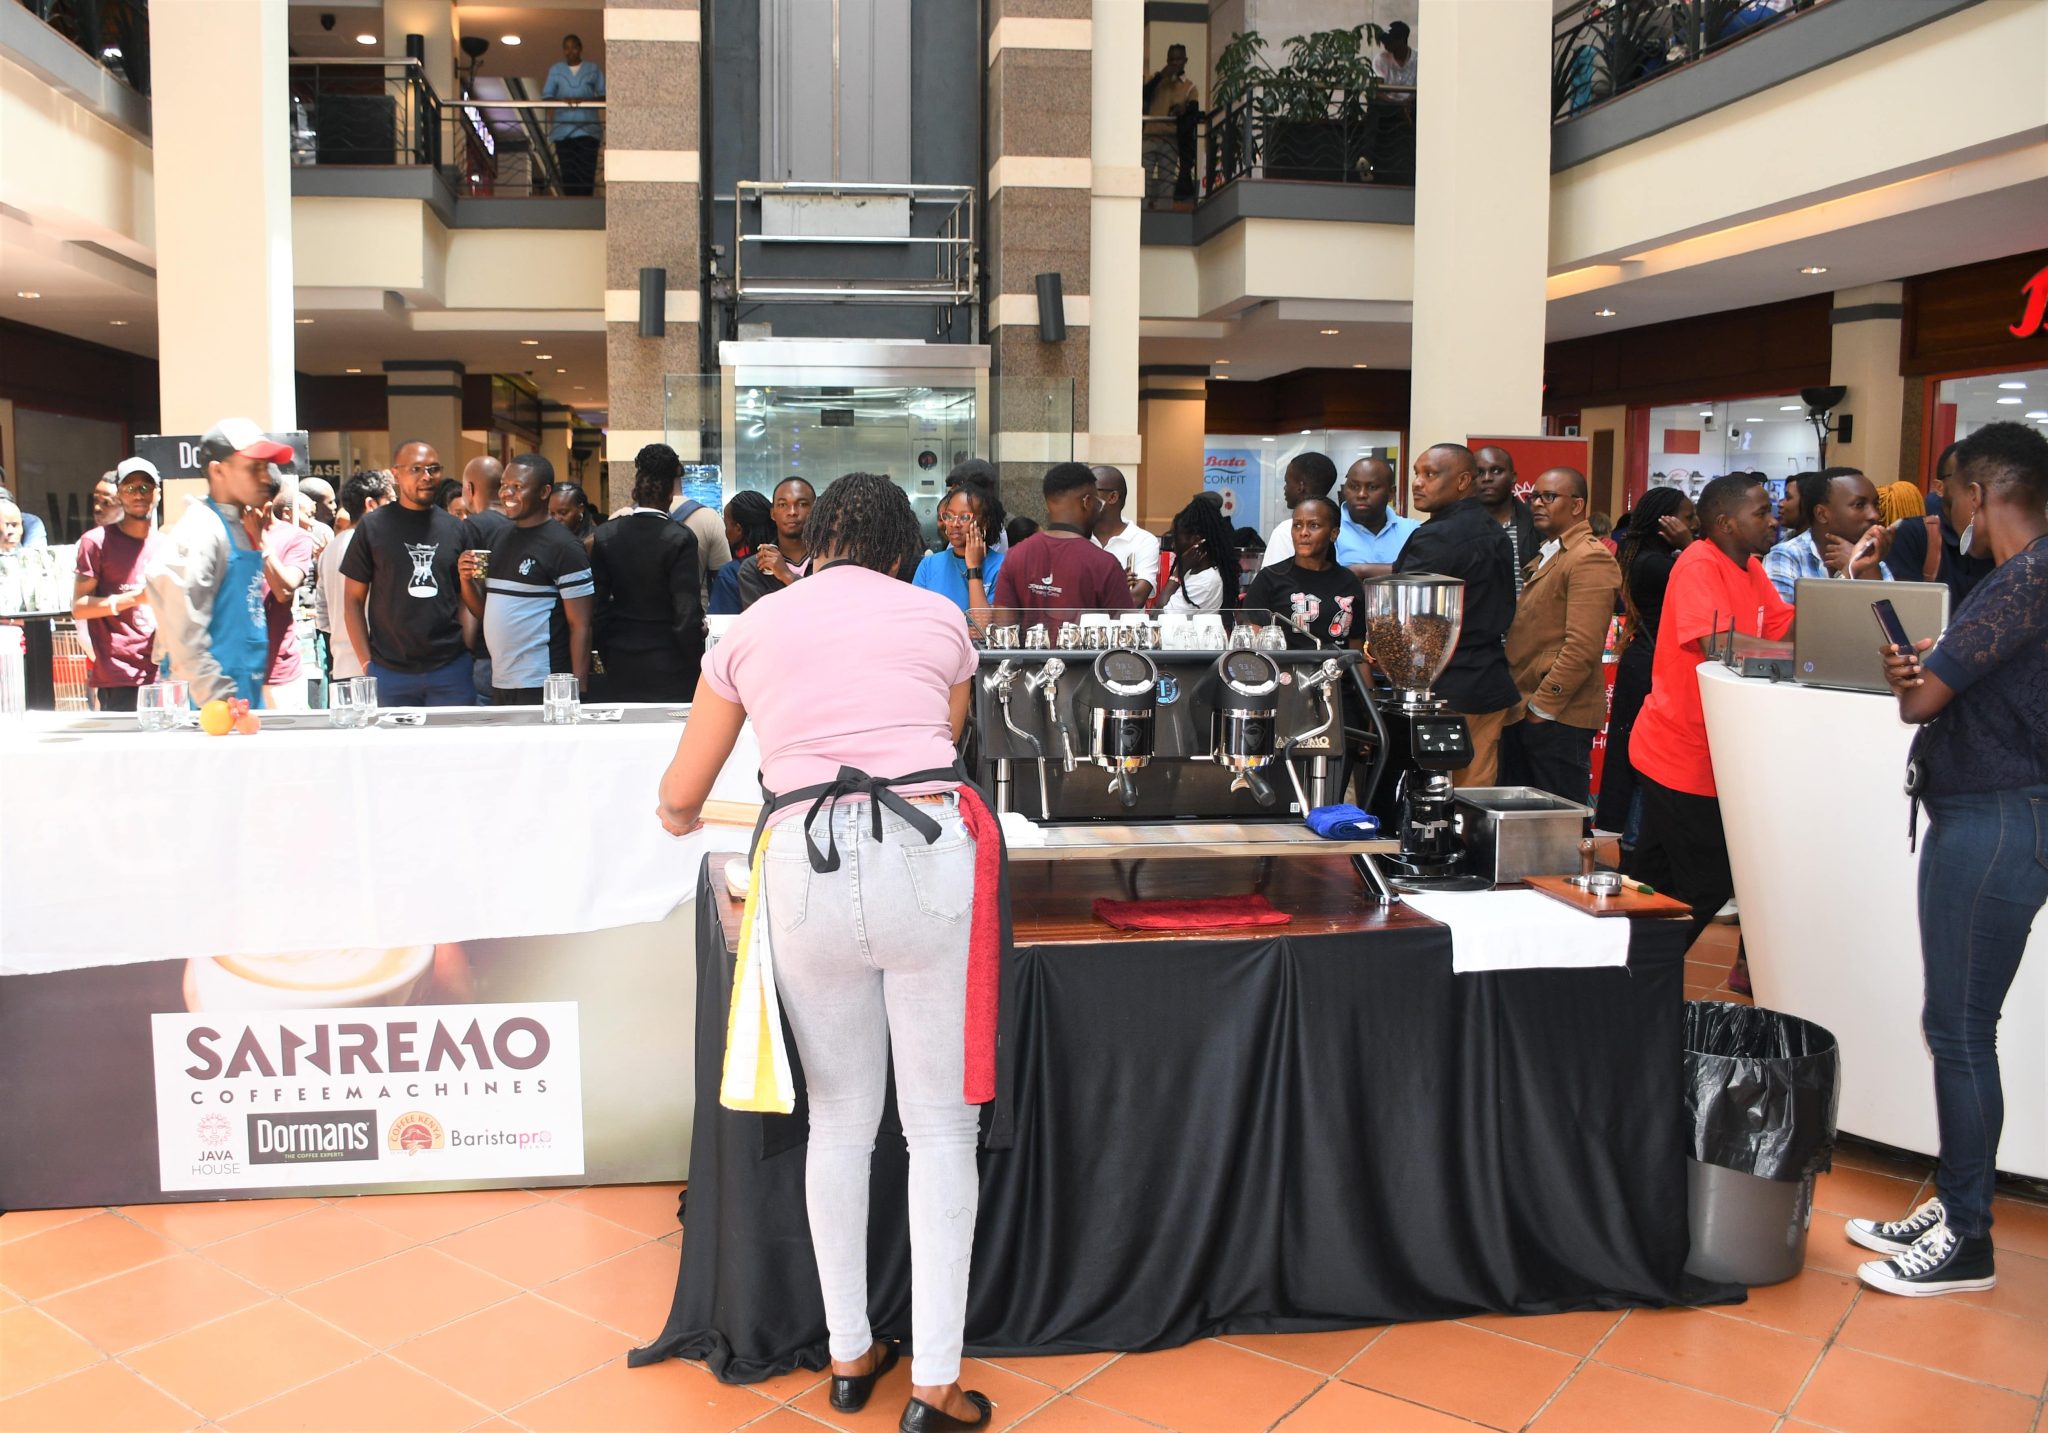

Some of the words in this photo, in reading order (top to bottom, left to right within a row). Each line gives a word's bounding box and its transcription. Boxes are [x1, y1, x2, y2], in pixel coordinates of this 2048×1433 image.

[1204, 455, 1248, 467] Bata
[1204, 475, 1246, 484] COMFIT
[185, 1016, 550, 1080] SANREMO
[191, 1080, 547, 1104] COFFEEMACHINES
[257, 1120, 368, 1153] Dormans
[390, 1115, 415, 1142] COFFEE
[418, 1115, 442, 1140] KENYA
[452, 1129, 551, 1150] Baristapro
[198, 1151, 233, 1162] JAVA
[192, 1163, 240, 1175] HOUSE
